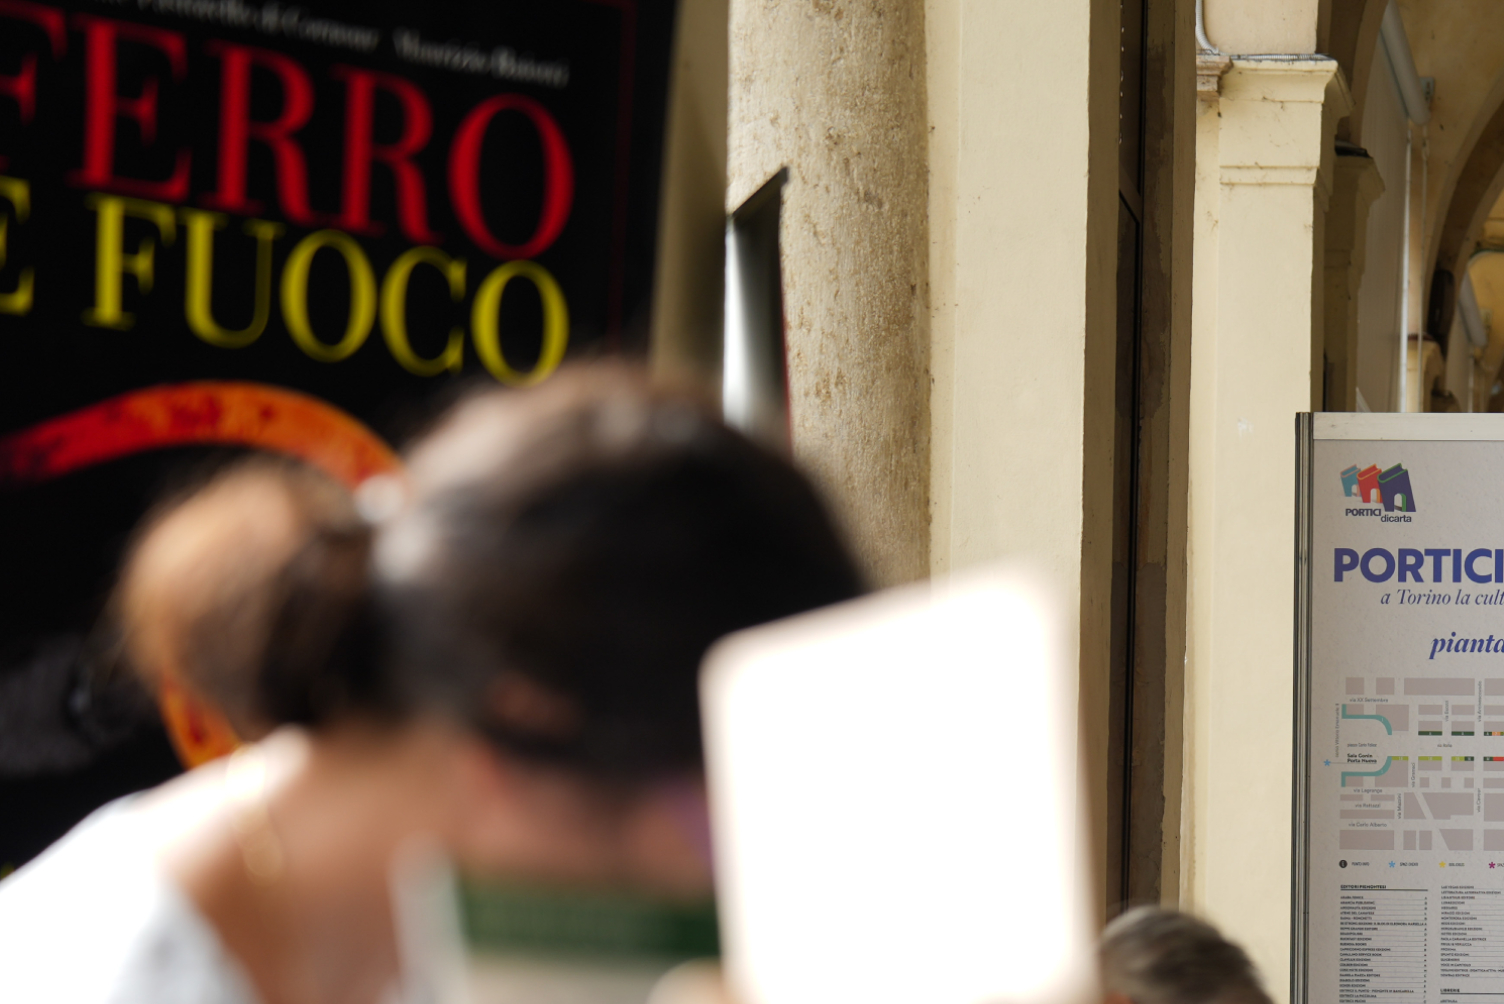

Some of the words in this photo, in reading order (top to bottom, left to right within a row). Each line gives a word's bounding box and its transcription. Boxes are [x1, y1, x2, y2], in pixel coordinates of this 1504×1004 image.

[84, 193, 570, 387] FUOCO
[1345, 508, 1381, 516] PORTICI
[1381, 514, 1412, 523] dicarta
[1334, 547, 1504, 583] PORTICI
[1381, 592, 1391, 605] a
[1396, 588, 1451, 606] Torino
[1455, 588, 1471, 605] la
